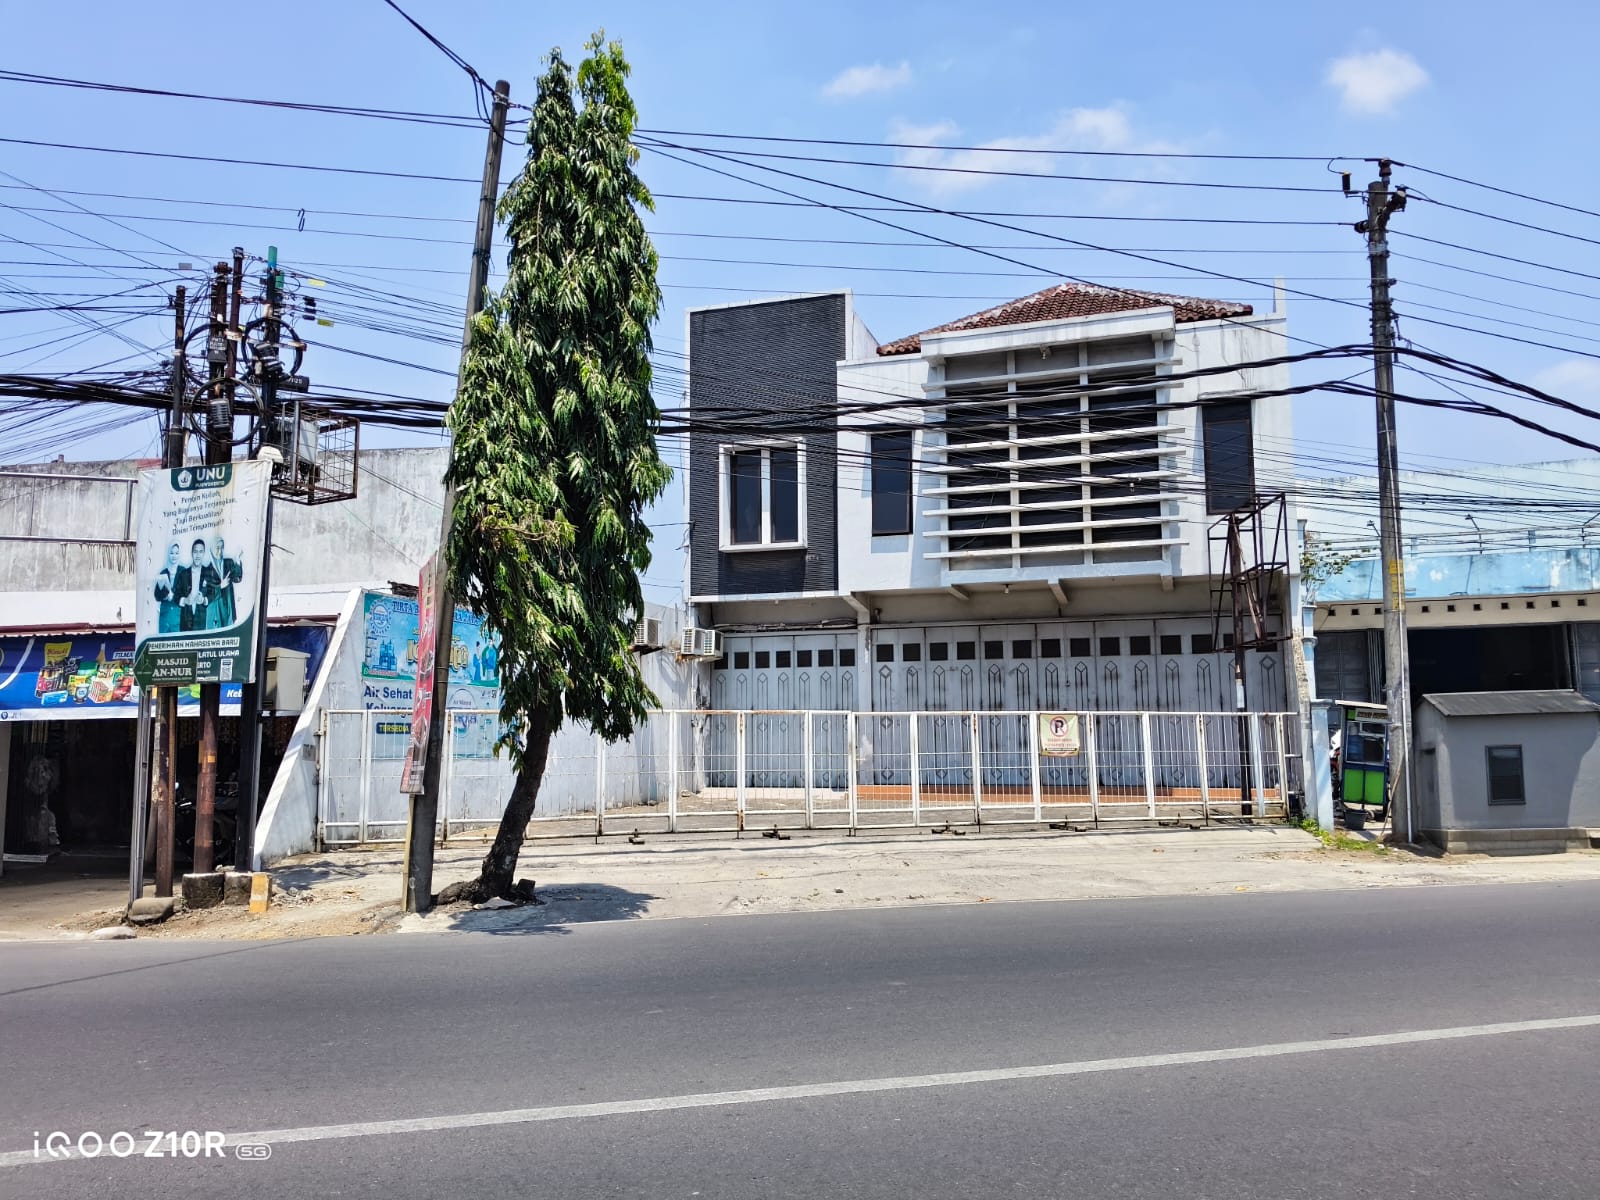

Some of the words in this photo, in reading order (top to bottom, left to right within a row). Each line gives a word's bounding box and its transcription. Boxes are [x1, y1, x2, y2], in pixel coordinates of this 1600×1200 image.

[196, 466, 226, 481] UNU
[184, 639, 220, 649] MAHASISWA
[221, 638, 238, 647] BARU
[198, 650, 217, 658] LATUL
[218, 649, 240, 657] ULAMA
[157, 657, 189, 666] MASJID
[152, 667, 192, 677] AN-NUR
[364, 685, 380, 698] Air
[383, 686, 412, 700] Sehat
